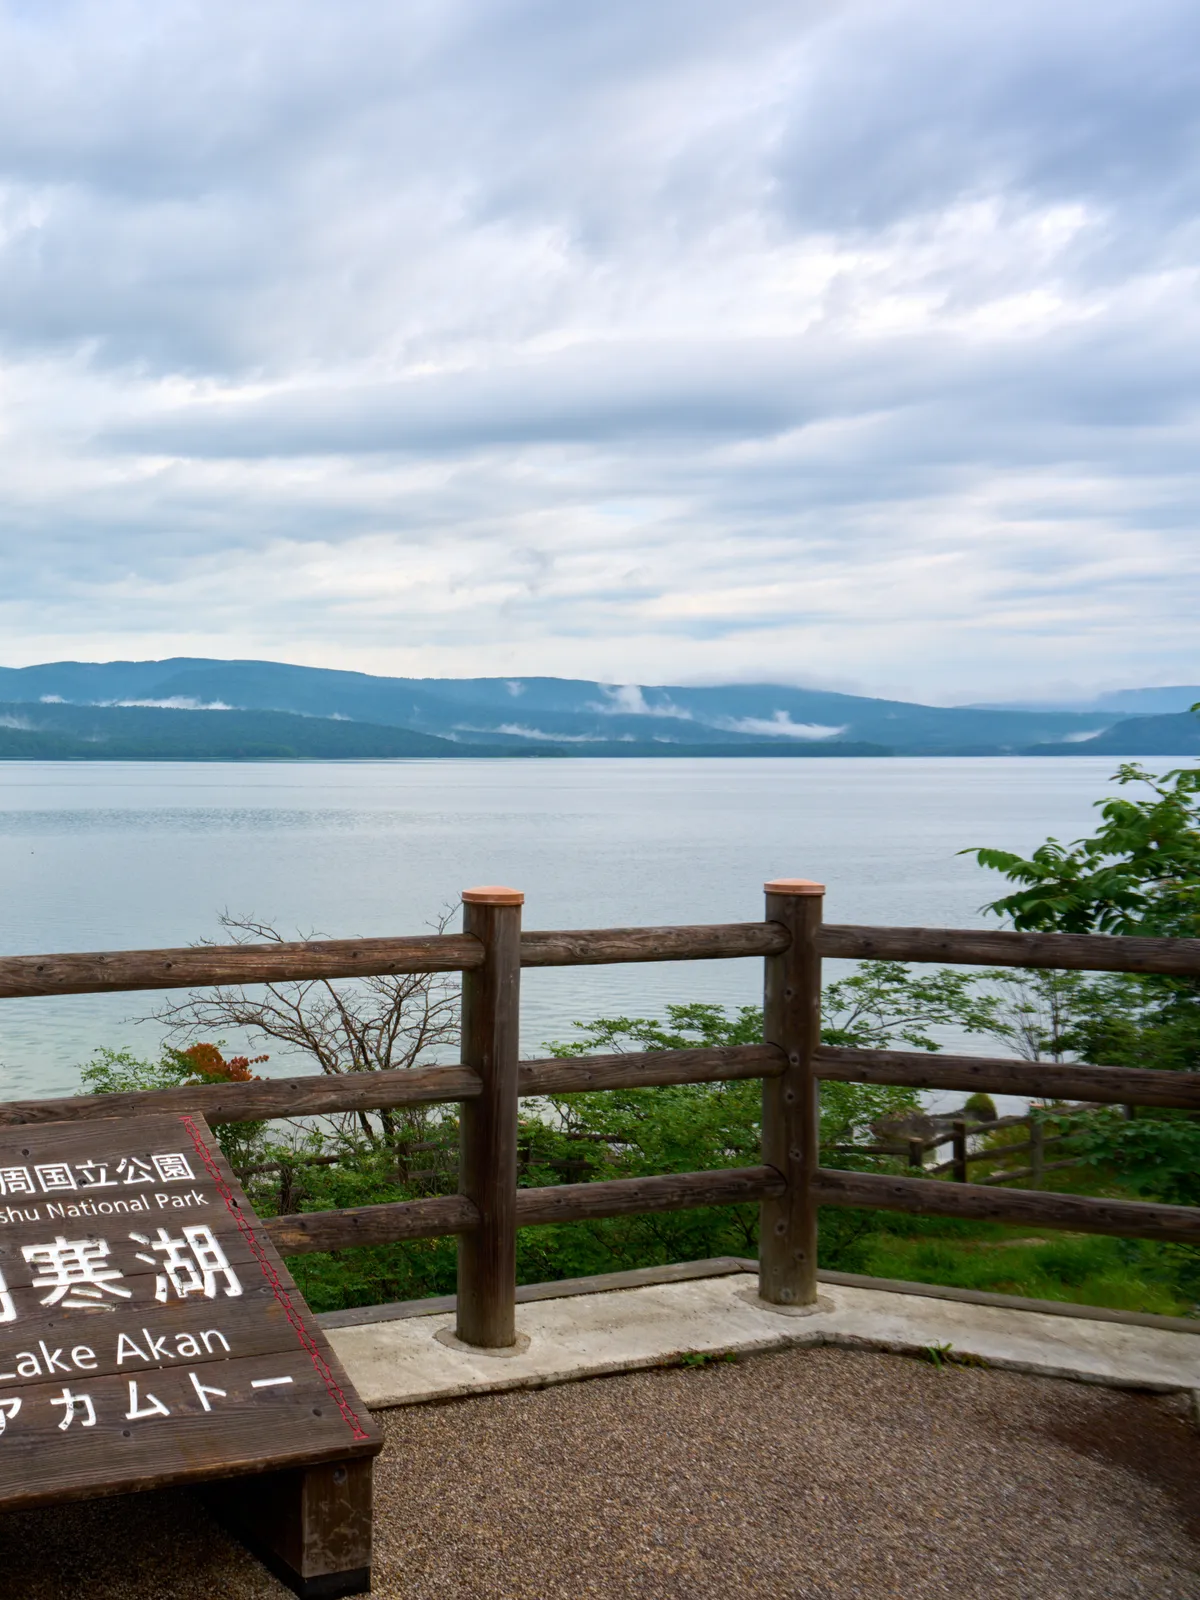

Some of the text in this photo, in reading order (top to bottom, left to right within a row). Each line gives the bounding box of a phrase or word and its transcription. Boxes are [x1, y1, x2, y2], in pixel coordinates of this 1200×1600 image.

[47, 1192, 152, 1220] National
[157, 1188, 210, 1210] Park
[116, 1328, 230, 1366] Akan
